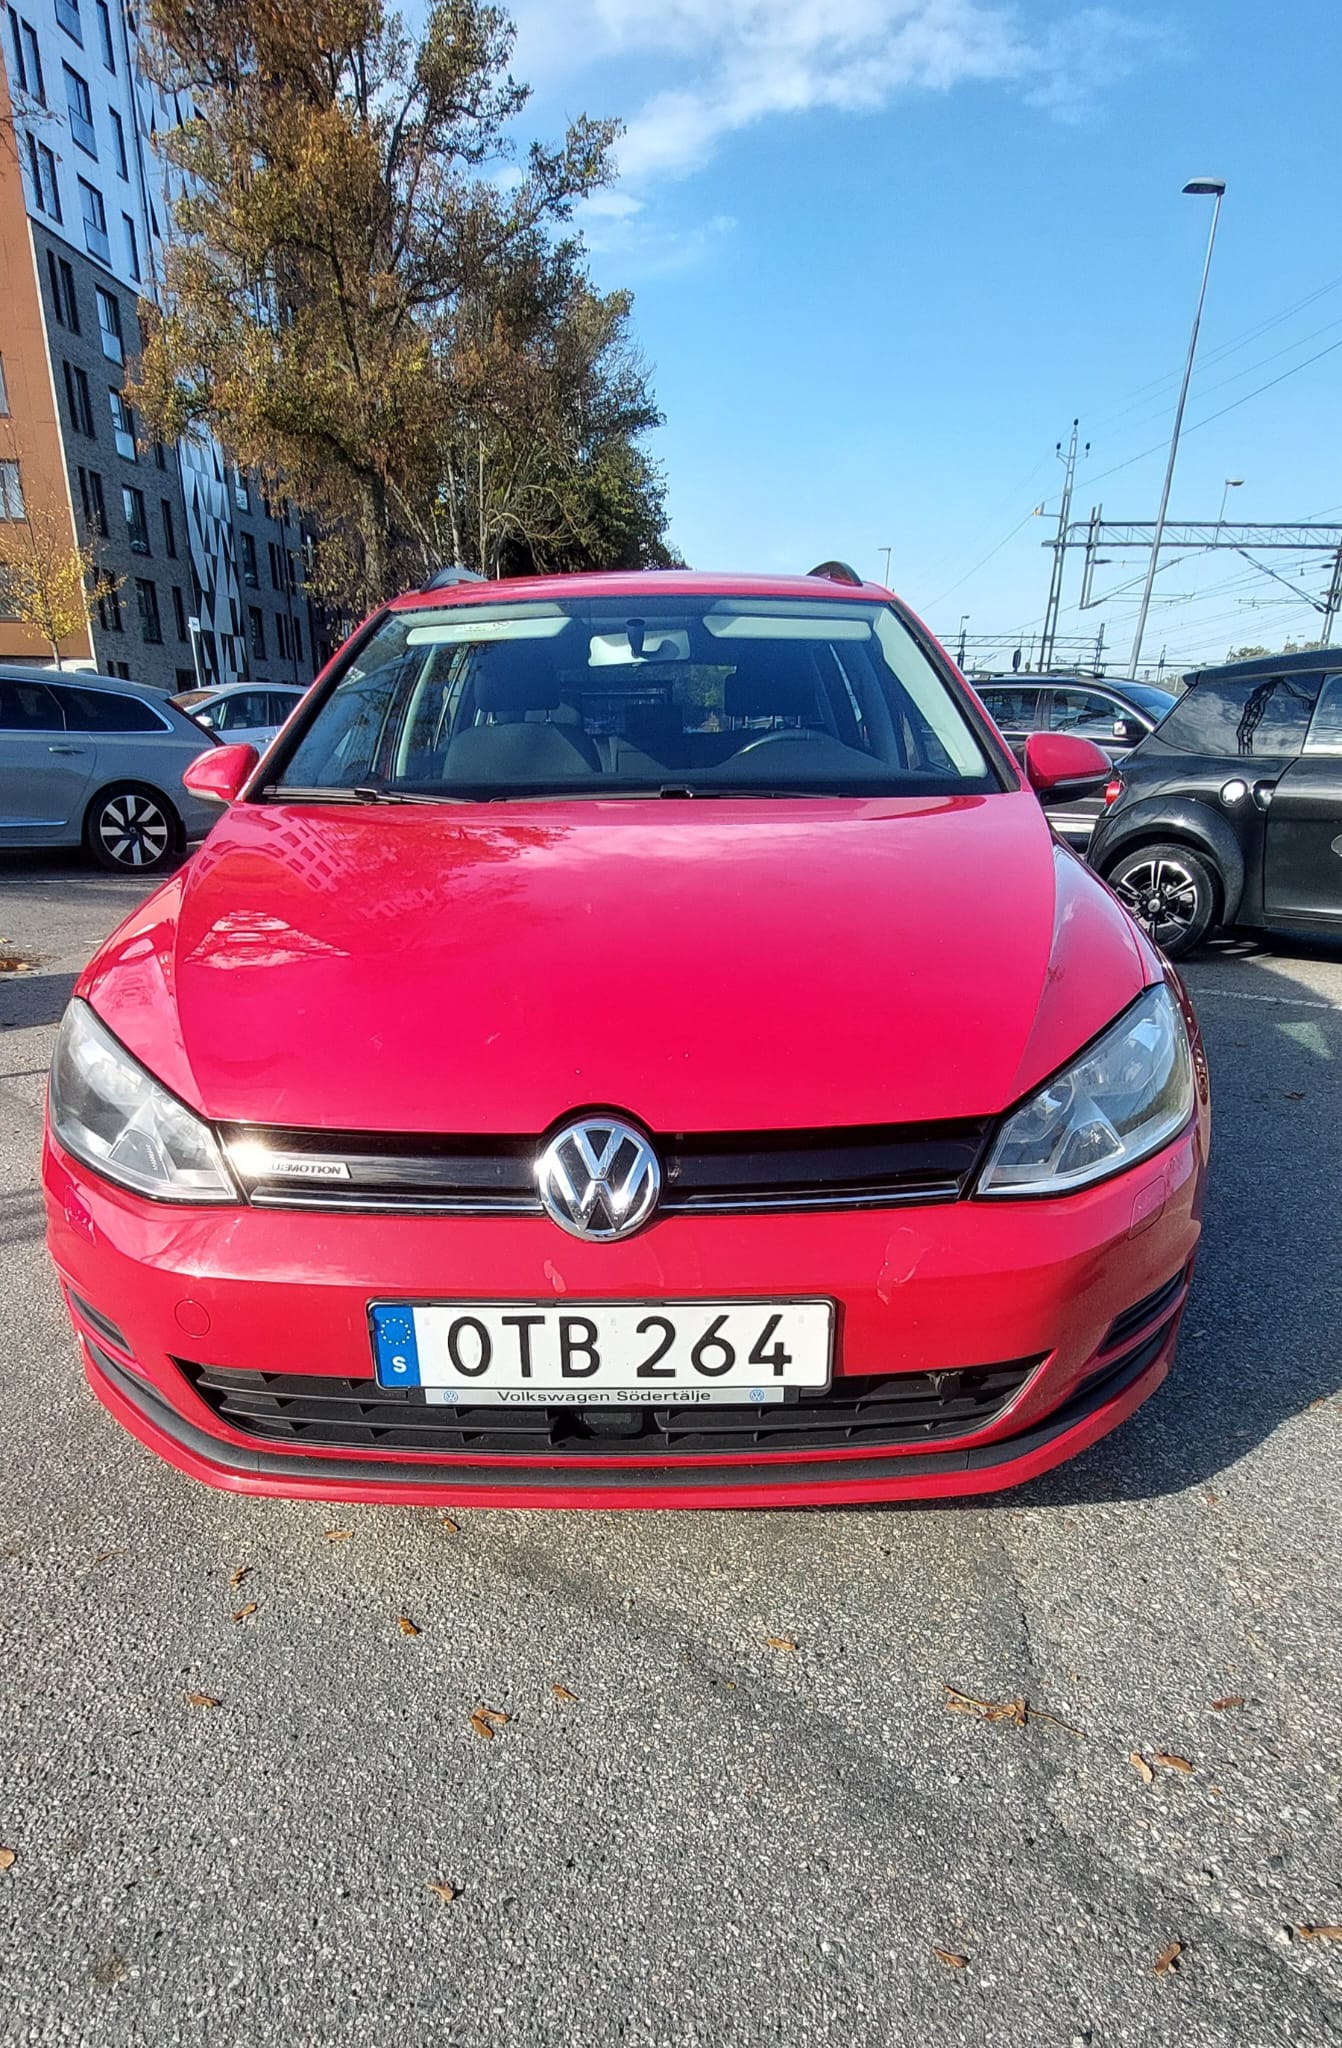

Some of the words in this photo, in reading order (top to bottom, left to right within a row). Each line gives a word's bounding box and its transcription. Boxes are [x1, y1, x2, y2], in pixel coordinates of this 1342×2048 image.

[448, 1316, 601, 1378] OTB
[637, 1315, 792, 1377] 264
[392, 1356, 407, 1374] S
[497, 1391, 609, 1404] Volkswagen
[616, 1390, 711, 1402] Södertälje
